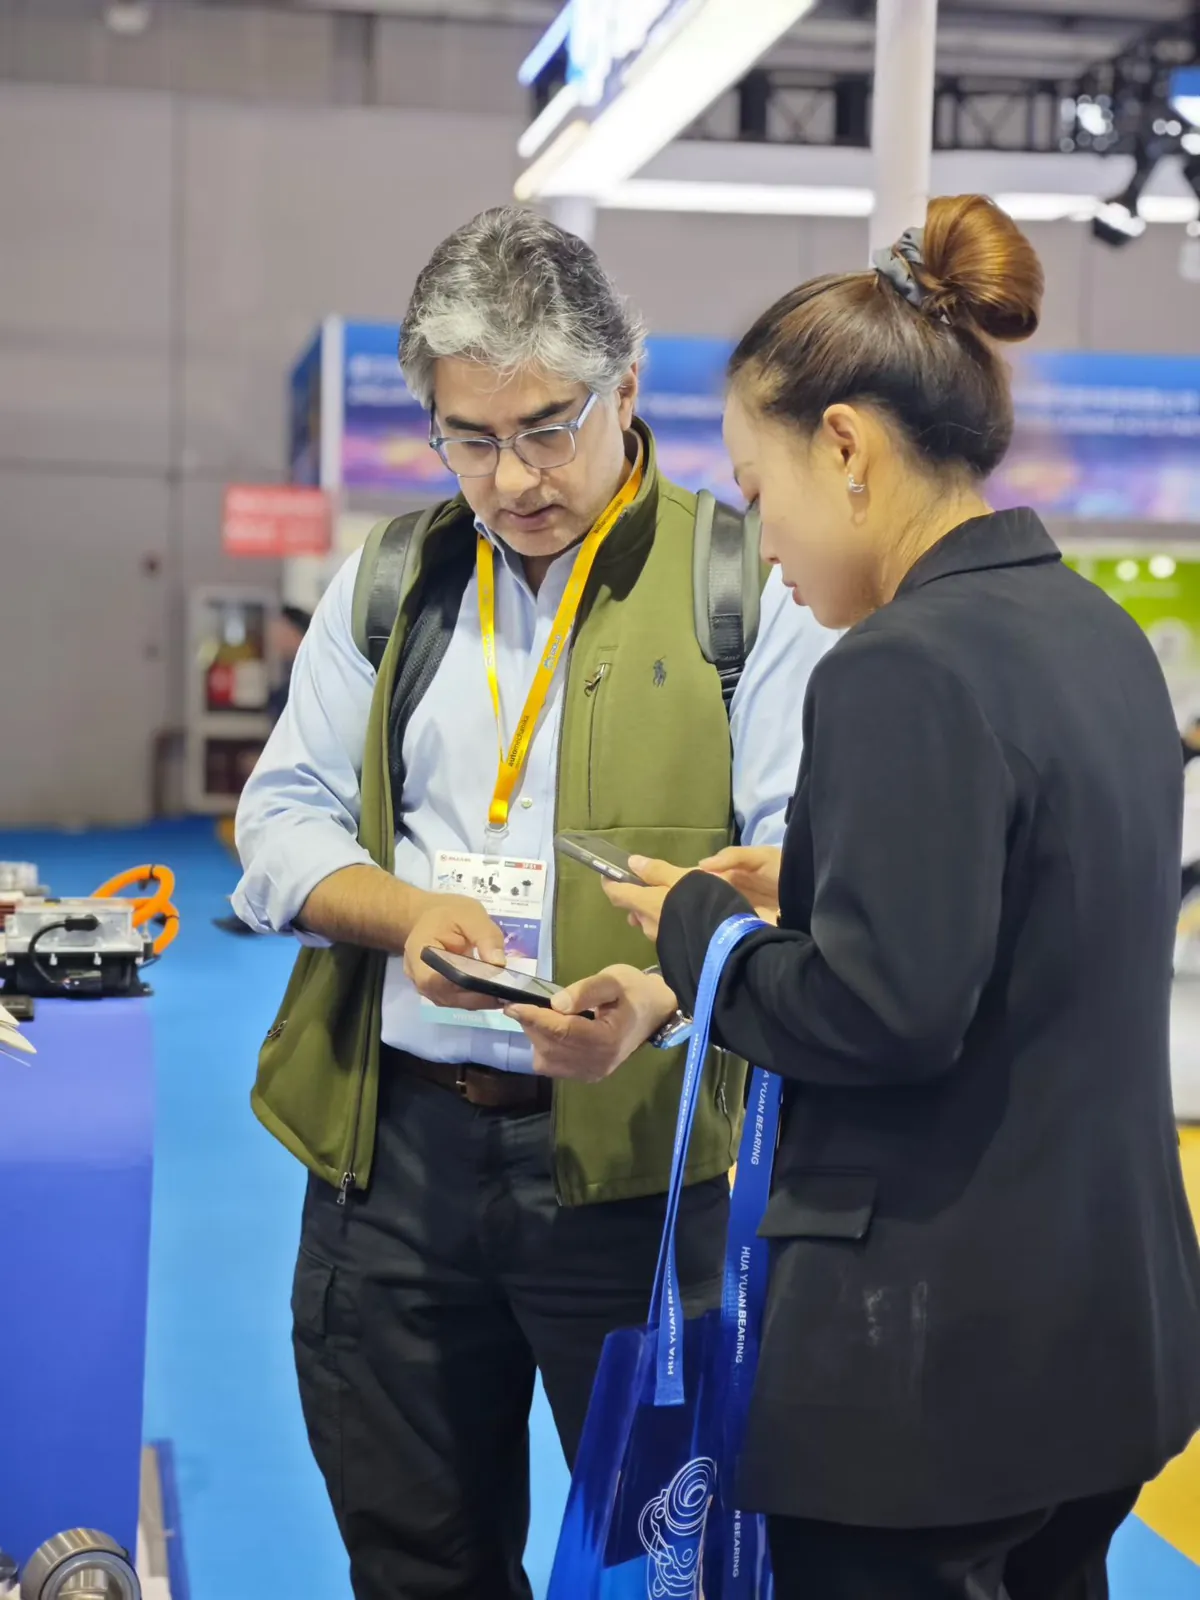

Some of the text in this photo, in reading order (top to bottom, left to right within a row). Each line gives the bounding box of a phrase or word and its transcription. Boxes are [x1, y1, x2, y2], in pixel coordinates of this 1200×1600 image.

[508, 715, 530, 767] automechanika
[757, 1082, 769, 1114] YUAN
[751, 1115, 764, 1166] BEARING
[668, 1307, 676, 1345] YUAN
[735, 1246, 751, 1364] HUA YUAN BEARING
[667, 1347, 676, 1376] HUA
[732, 1522, 741, 1578] BEARING
